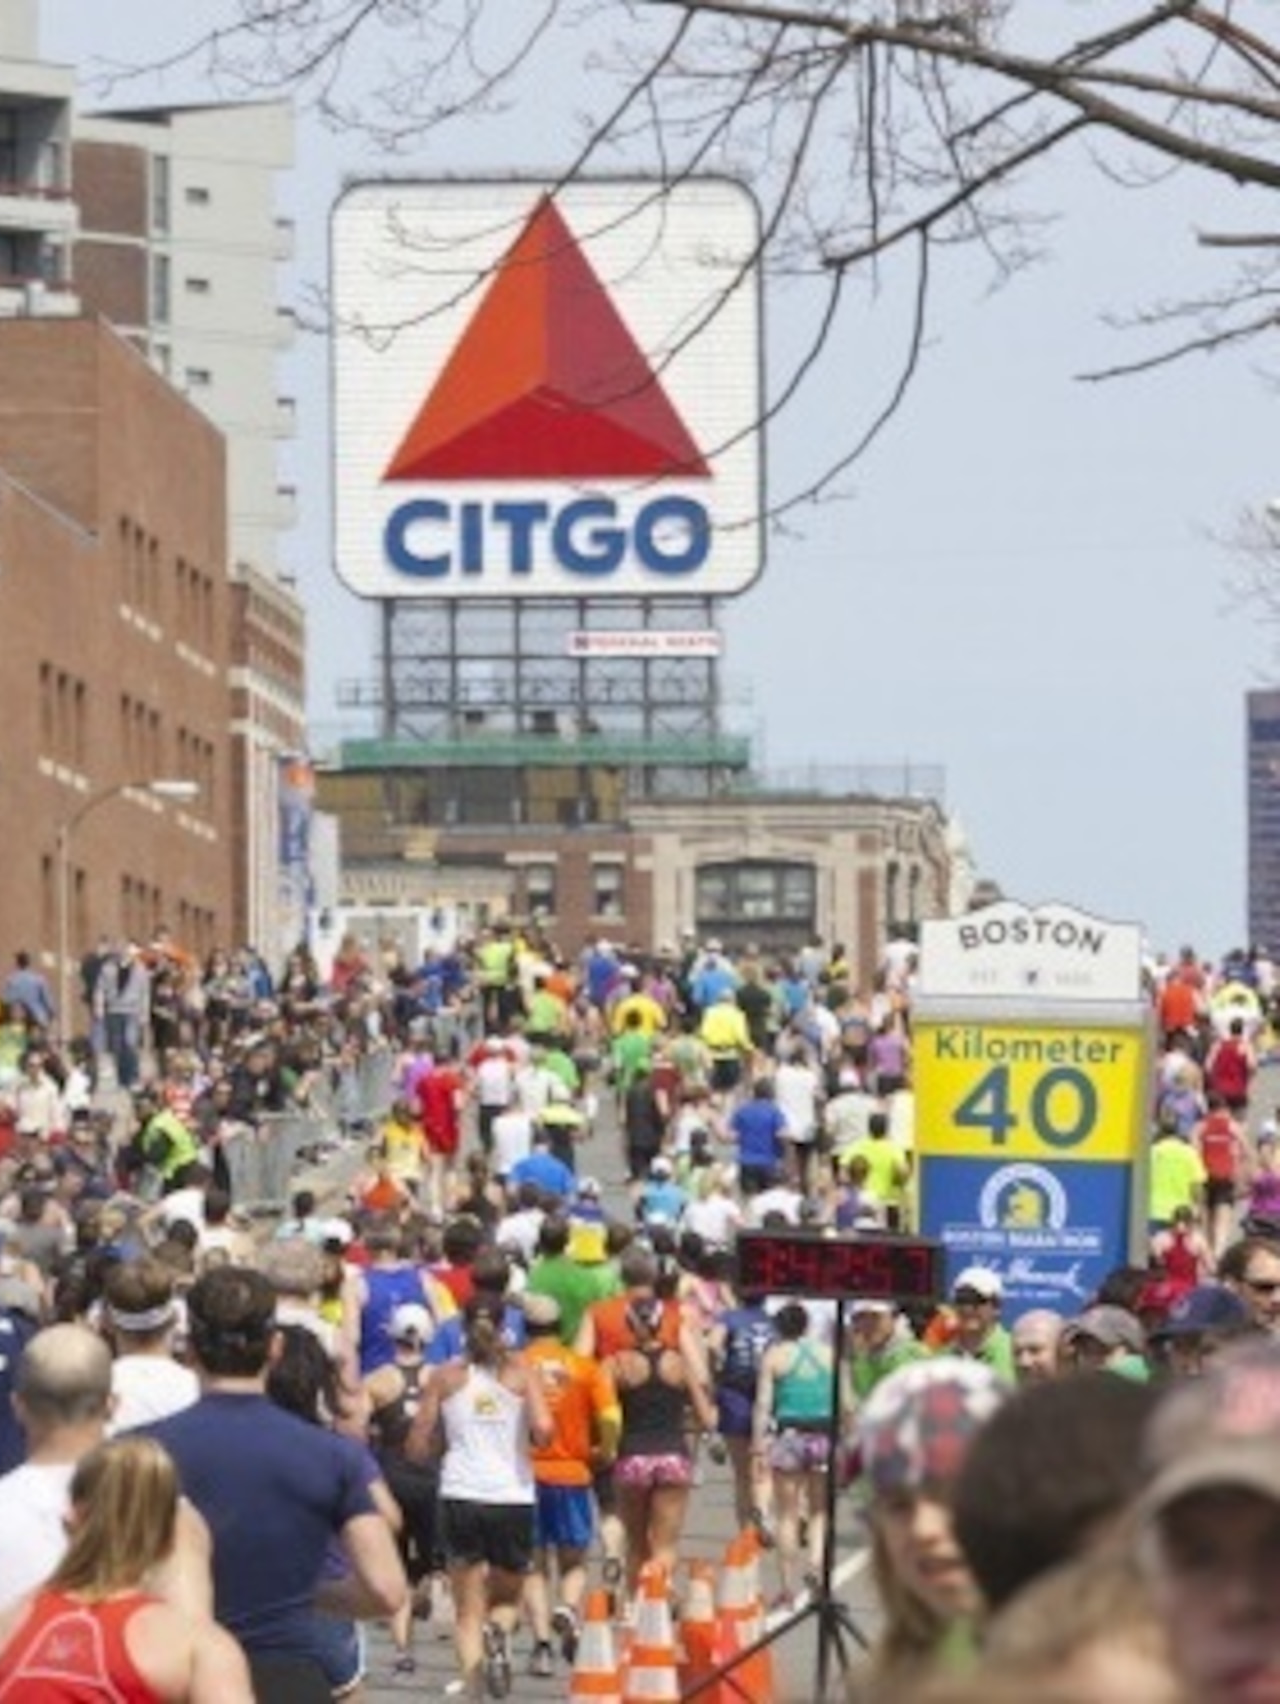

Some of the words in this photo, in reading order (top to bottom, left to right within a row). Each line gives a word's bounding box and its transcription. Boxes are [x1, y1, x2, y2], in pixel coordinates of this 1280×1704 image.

[383, 494, 714, 579] CITGO
[958, 917, 1106, 954] BOSTON
[934, 1029, 1125, 1064] Kilometer
[952, 1064, 1098, 1149] 40
